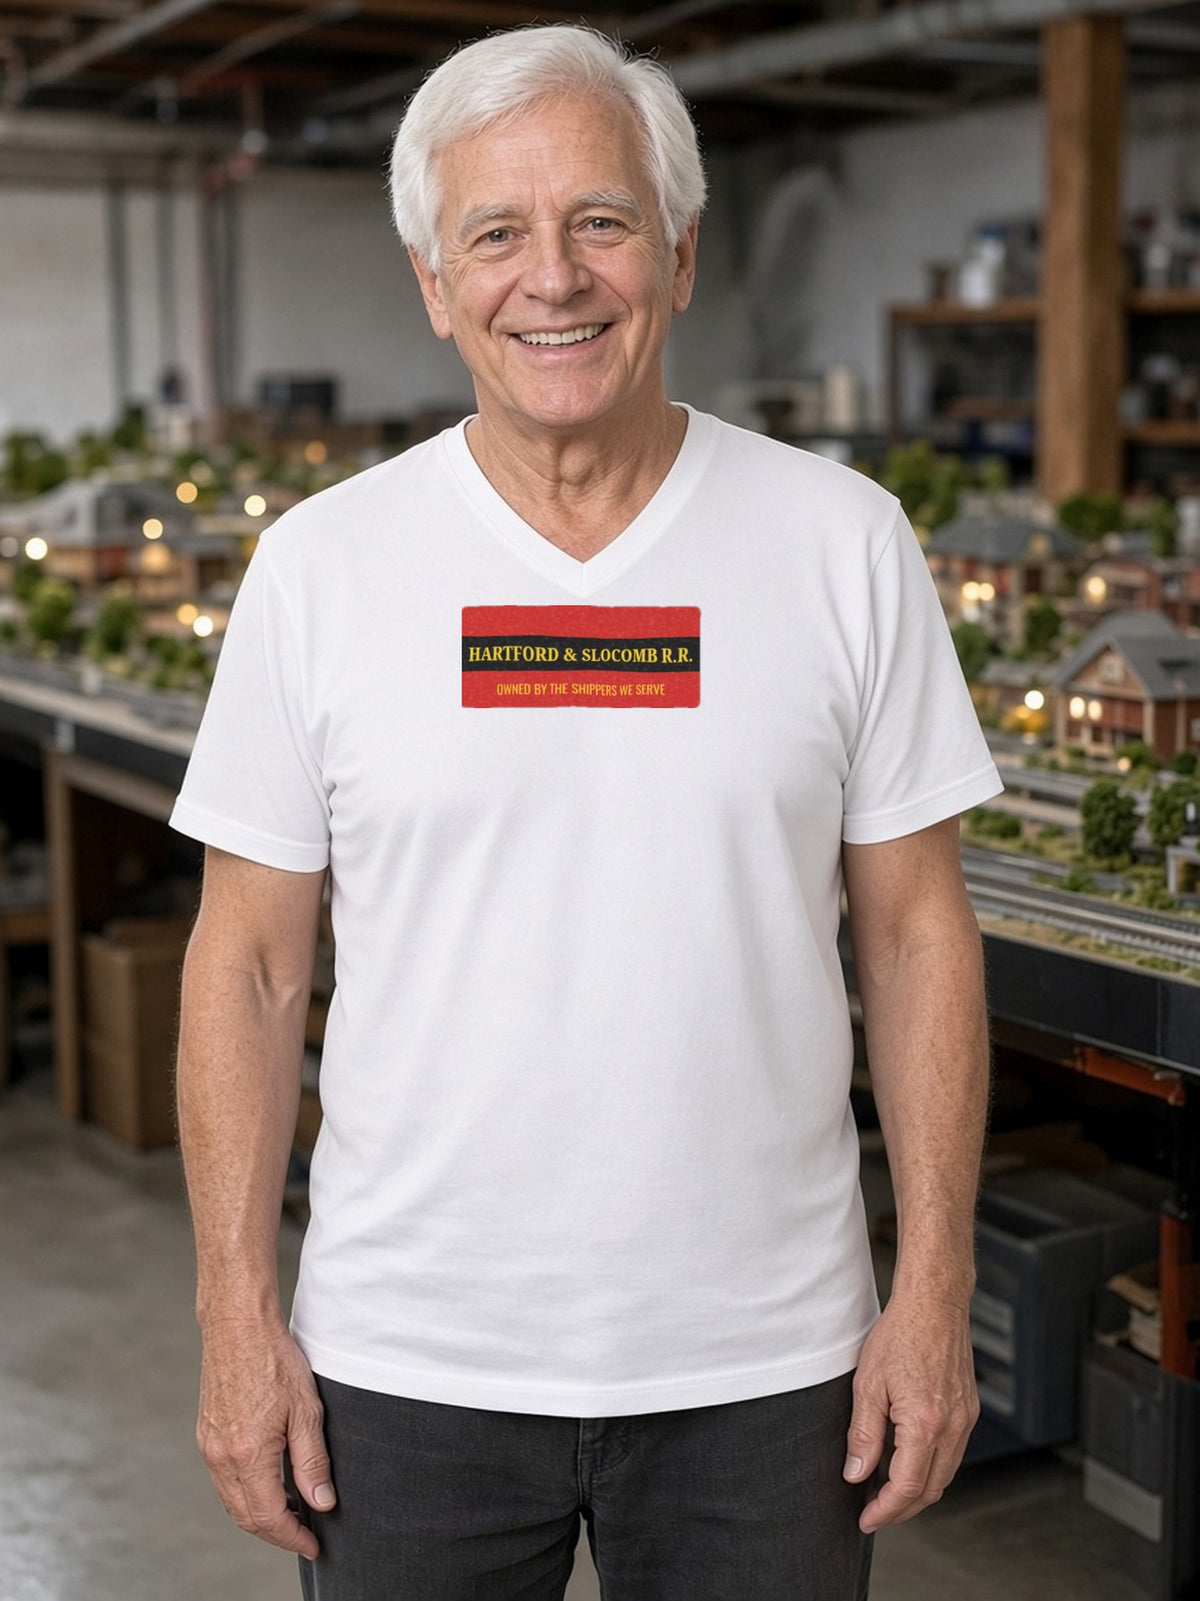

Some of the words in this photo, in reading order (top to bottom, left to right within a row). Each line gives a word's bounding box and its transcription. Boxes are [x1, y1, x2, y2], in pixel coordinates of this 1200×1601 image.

[468, 645, 559, 662] HARTFORD
[563, 647, 578, 662] &
[582, 648, 658, 663] SLOCOMB
[662, 647, 693, 663] R.R.
[496, 683, 532, 696] OWNED
[534, 683, 548, 695] BY
[550, 682, 569, 695] THE
[571, 682, 618, 697] SHIPPERS
[620, 684, 634, 696] WE
[635, 683, 666, 696] SERVE
